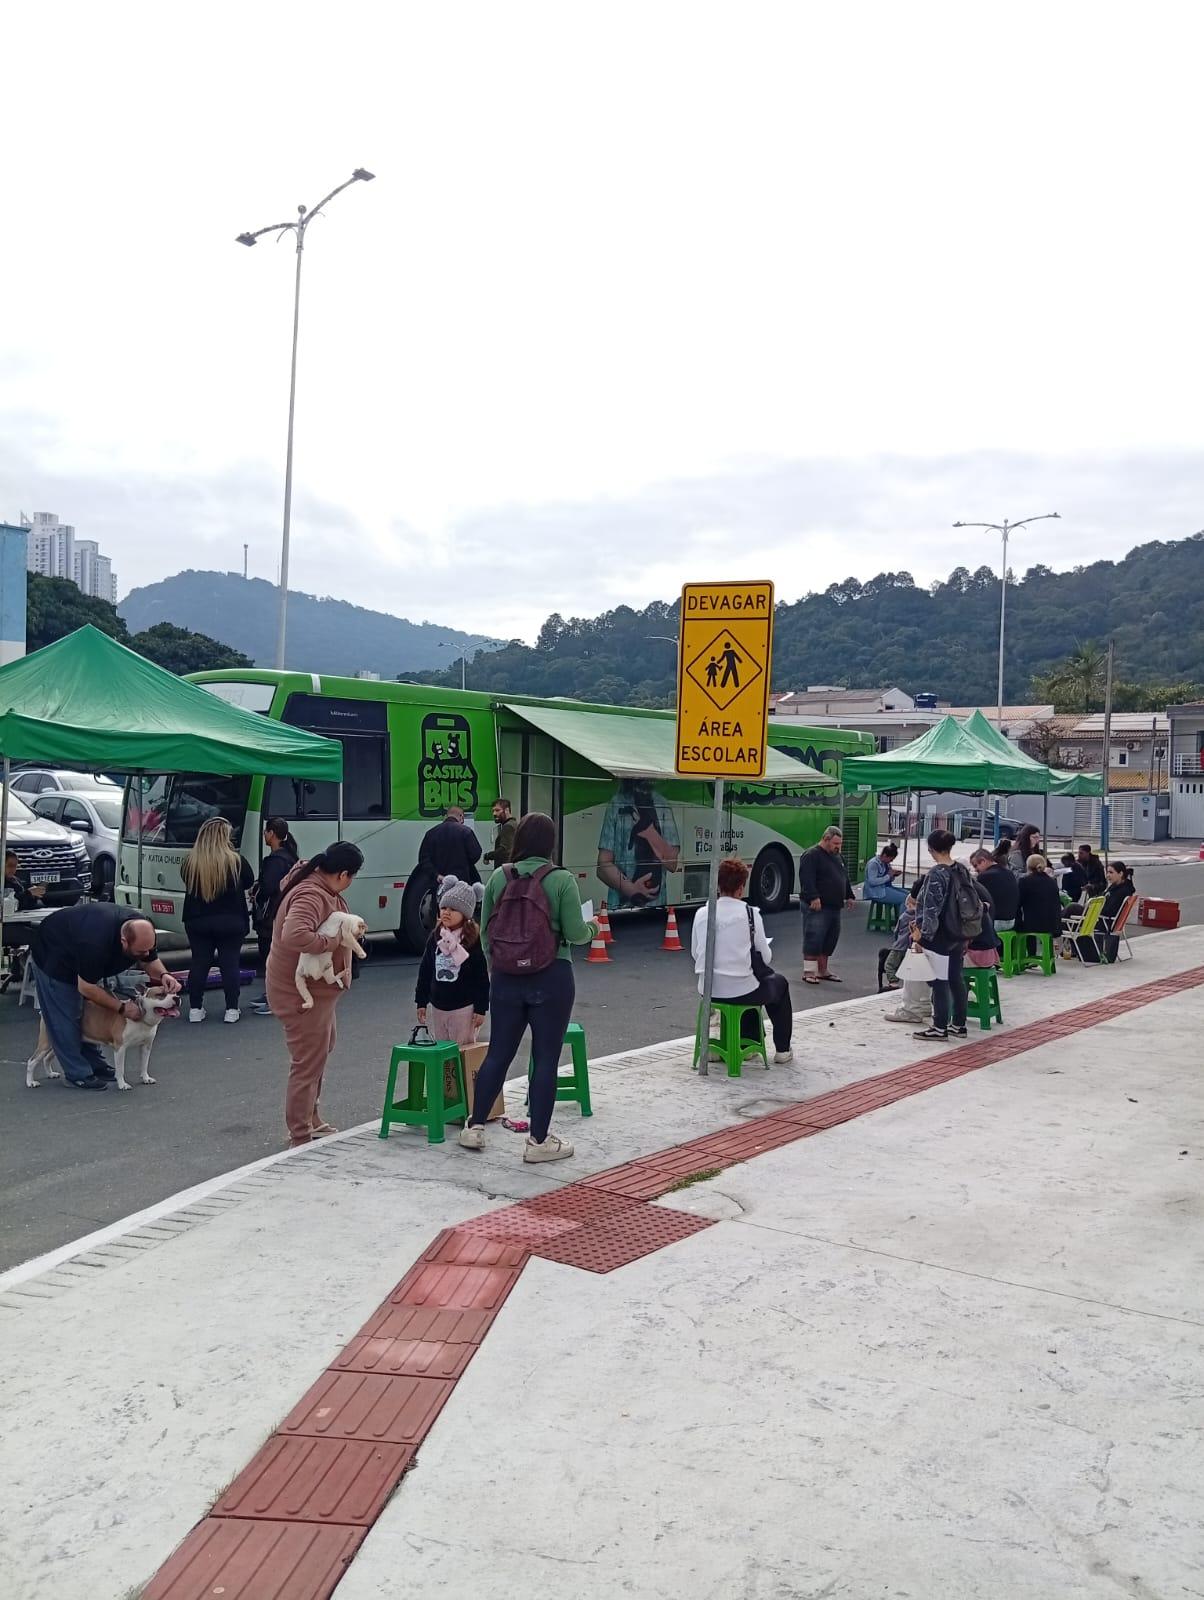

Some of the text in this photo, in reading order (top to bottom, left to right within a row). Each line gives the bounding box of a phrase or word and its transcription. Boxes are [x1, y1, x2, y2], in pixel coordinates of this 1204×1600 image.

[687, 595, 766, 611] DEVAGAR
[698, 716, 743, 737] ÁREA
[681, 746, 758, 763] ESCOLAR
[424, 765, 473, 779] CASTRA
[423, 780, 474, 811] BUS
